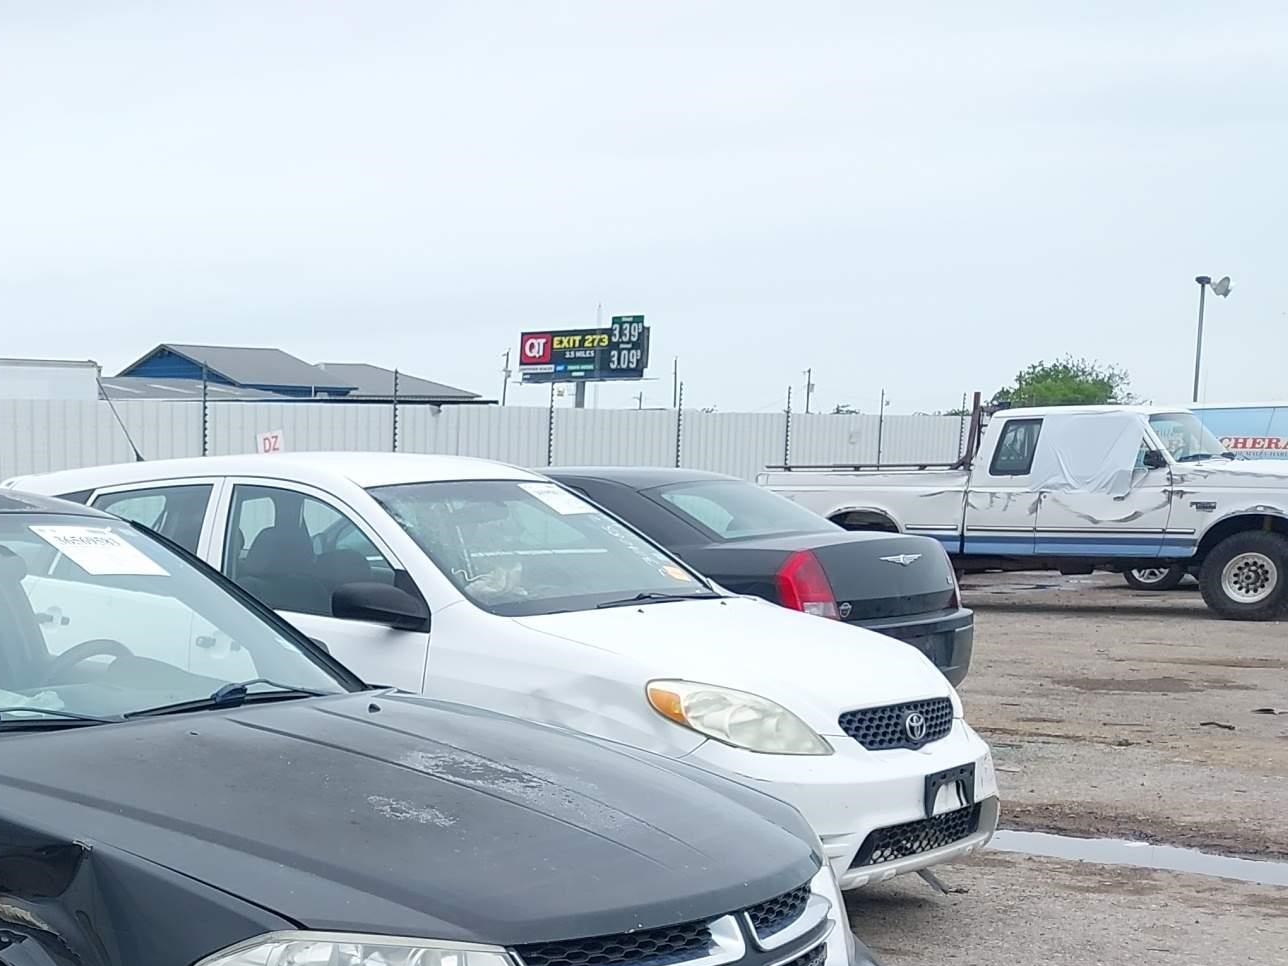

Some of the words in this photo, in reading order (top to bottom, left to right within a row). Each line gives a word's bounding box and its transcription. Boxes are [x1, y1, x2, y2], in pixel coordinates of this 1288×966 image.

[524, 338, 546, 359] QT
[553, 336, 582, 349] EXIT
[584, 334, 609, 347] 273
[263, 435, 280, 453] DZ
